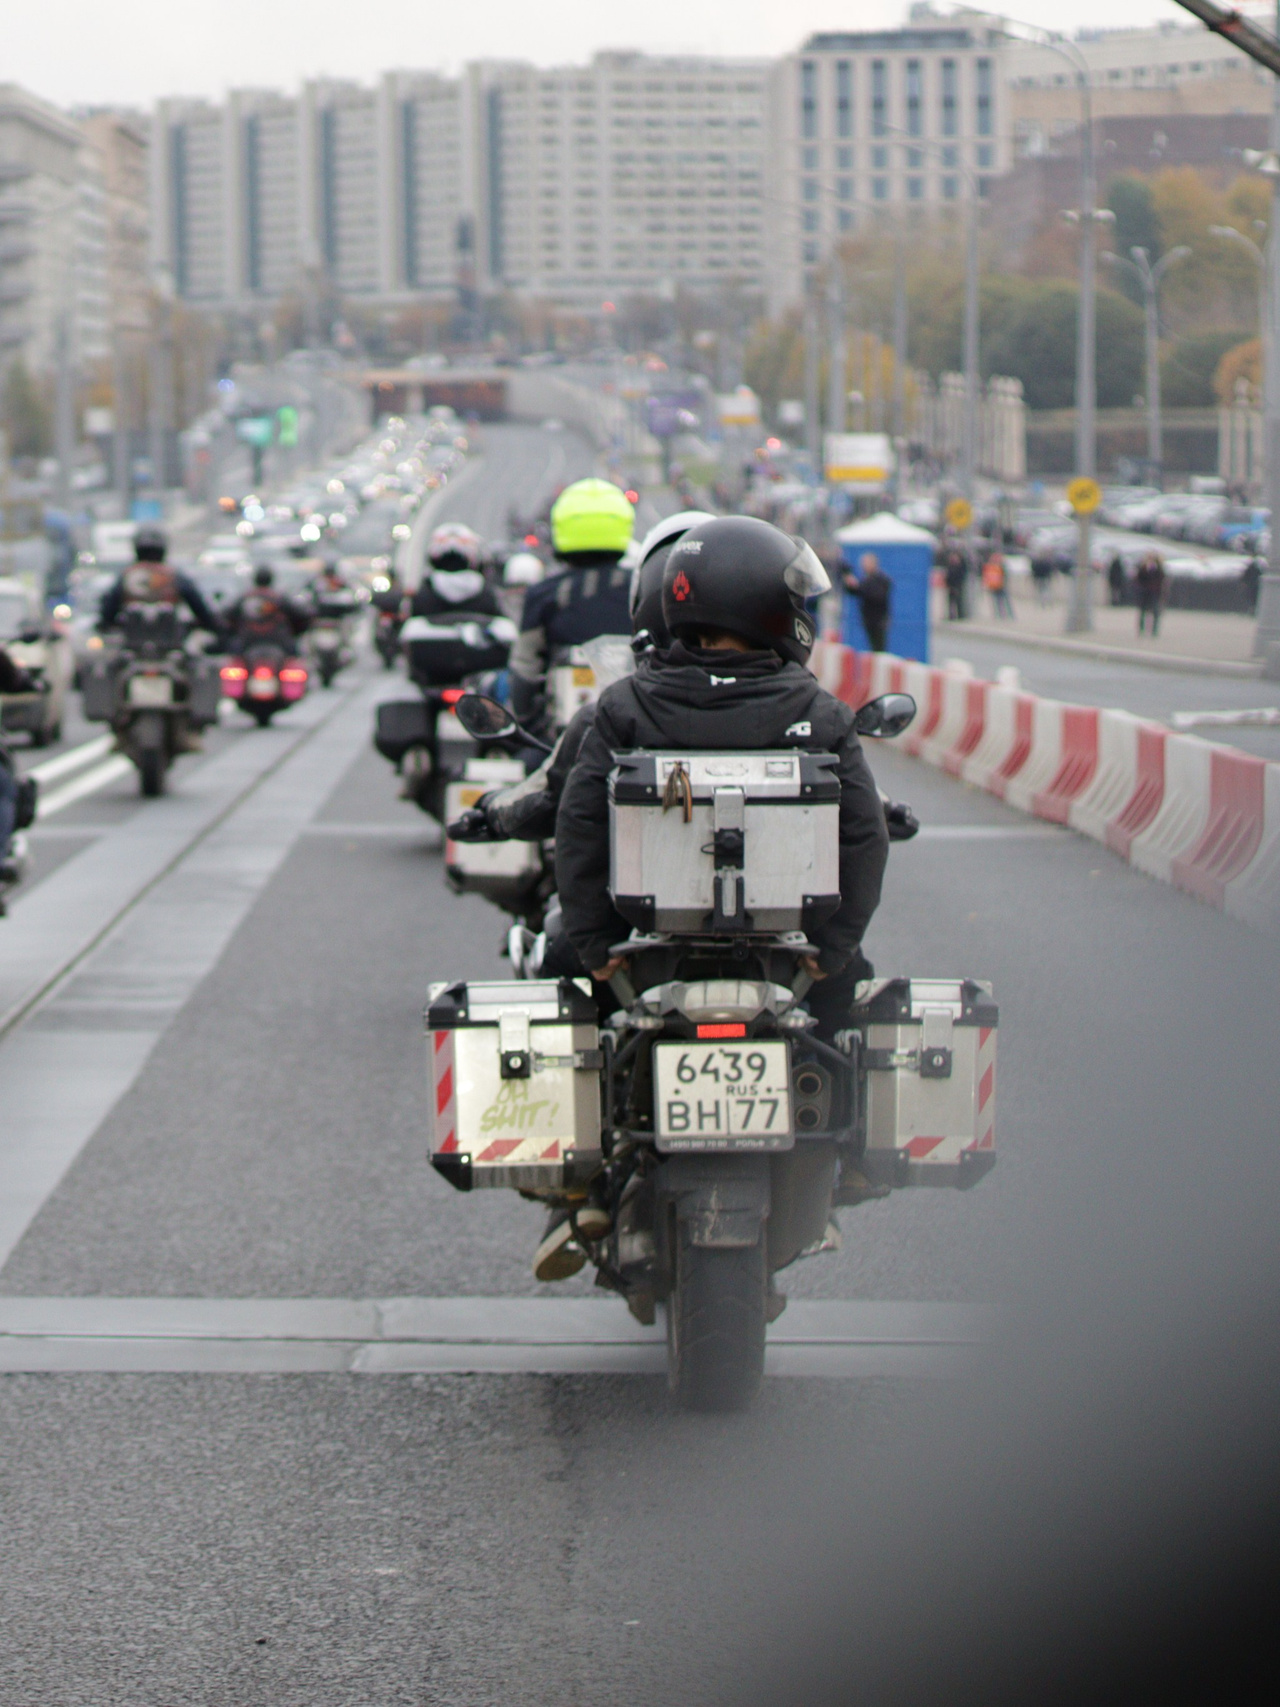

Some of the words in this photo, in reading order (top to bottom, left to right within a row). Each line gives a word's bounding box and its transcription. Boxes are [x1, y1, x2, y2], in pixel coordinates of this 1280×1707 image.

[676, 1052, 766, 1083] 6439
[726, 1085, 758, 1096] RUS
[735, 1099, 779, 1130] 77
